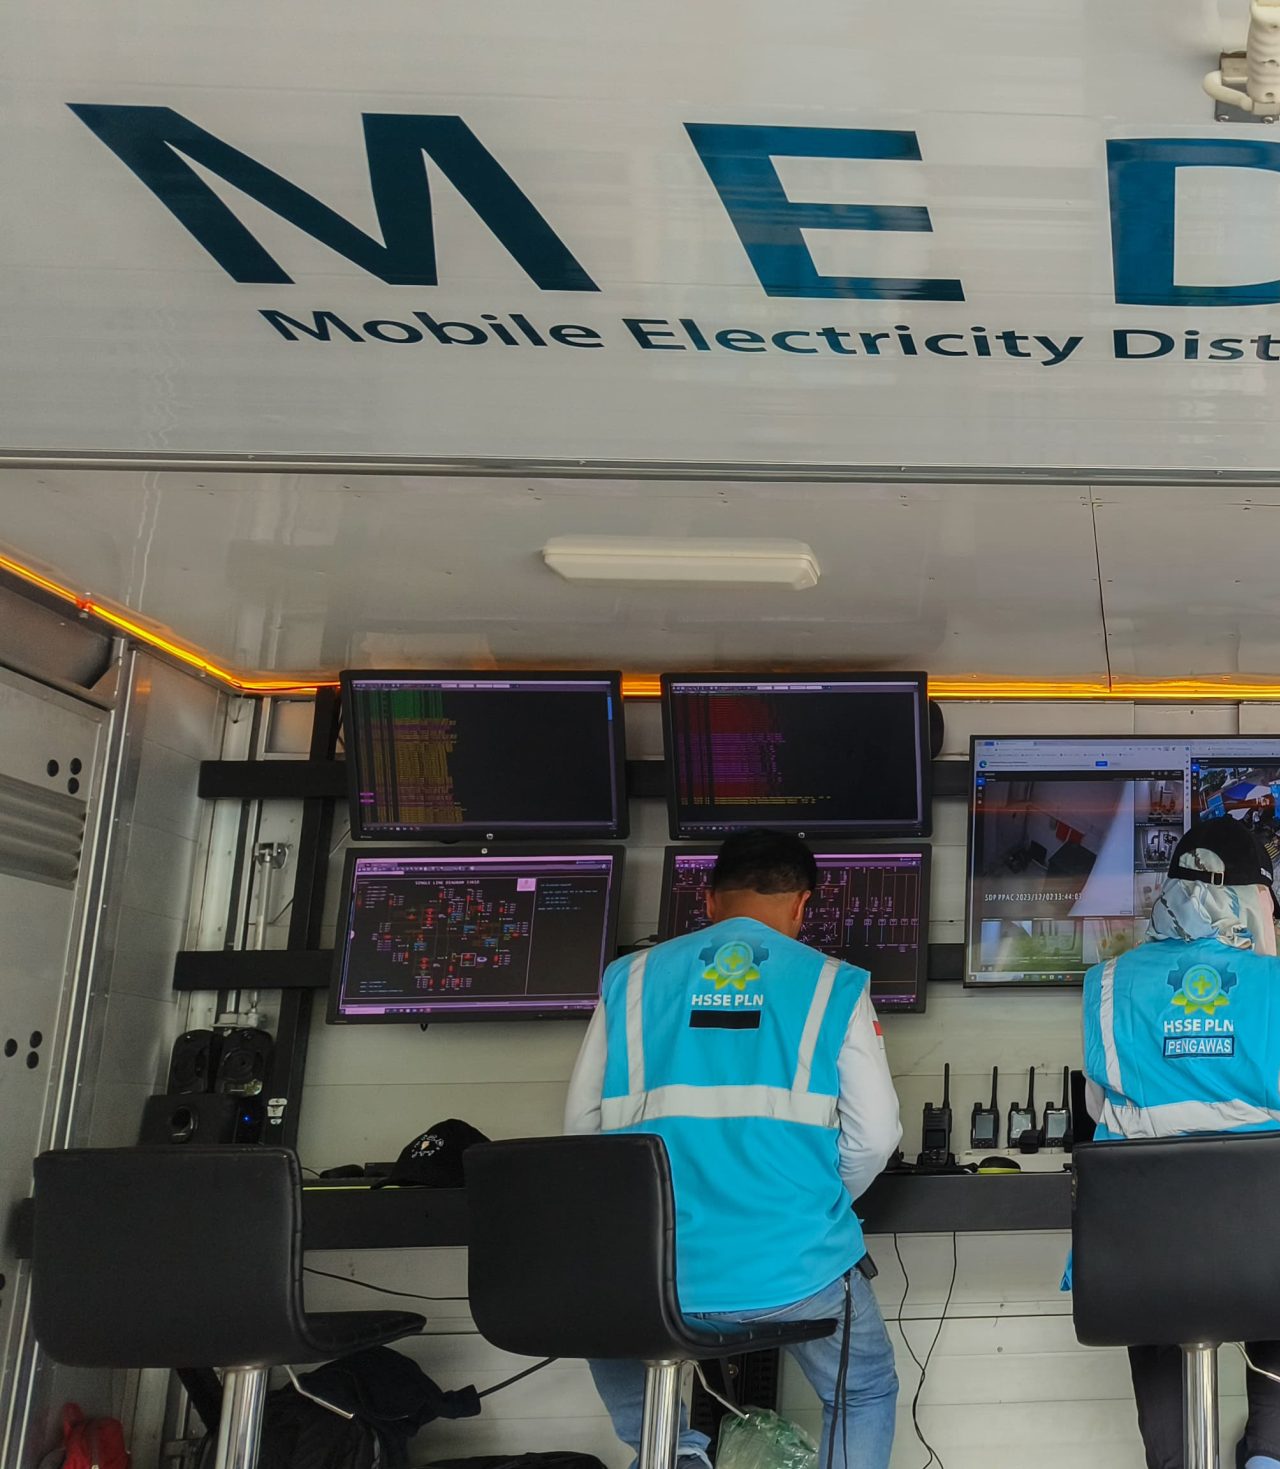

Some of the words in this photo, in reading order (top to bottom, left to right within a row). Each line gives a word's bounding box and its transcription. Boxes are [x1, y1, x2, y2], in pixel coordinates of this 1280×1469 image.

[262, 310, 605, 350] Mobile
[627, 319, 1082, 365] Electricity
[691, 993, 732, 1007] HSSE
[734, 993, 764, 1007] PLN
[1163, 1018, 1202, 1034] HSSE
[1204, 1018, 1235, 1033] PLN
[1167, 1039, 1232, 1054] PENGAWAS
